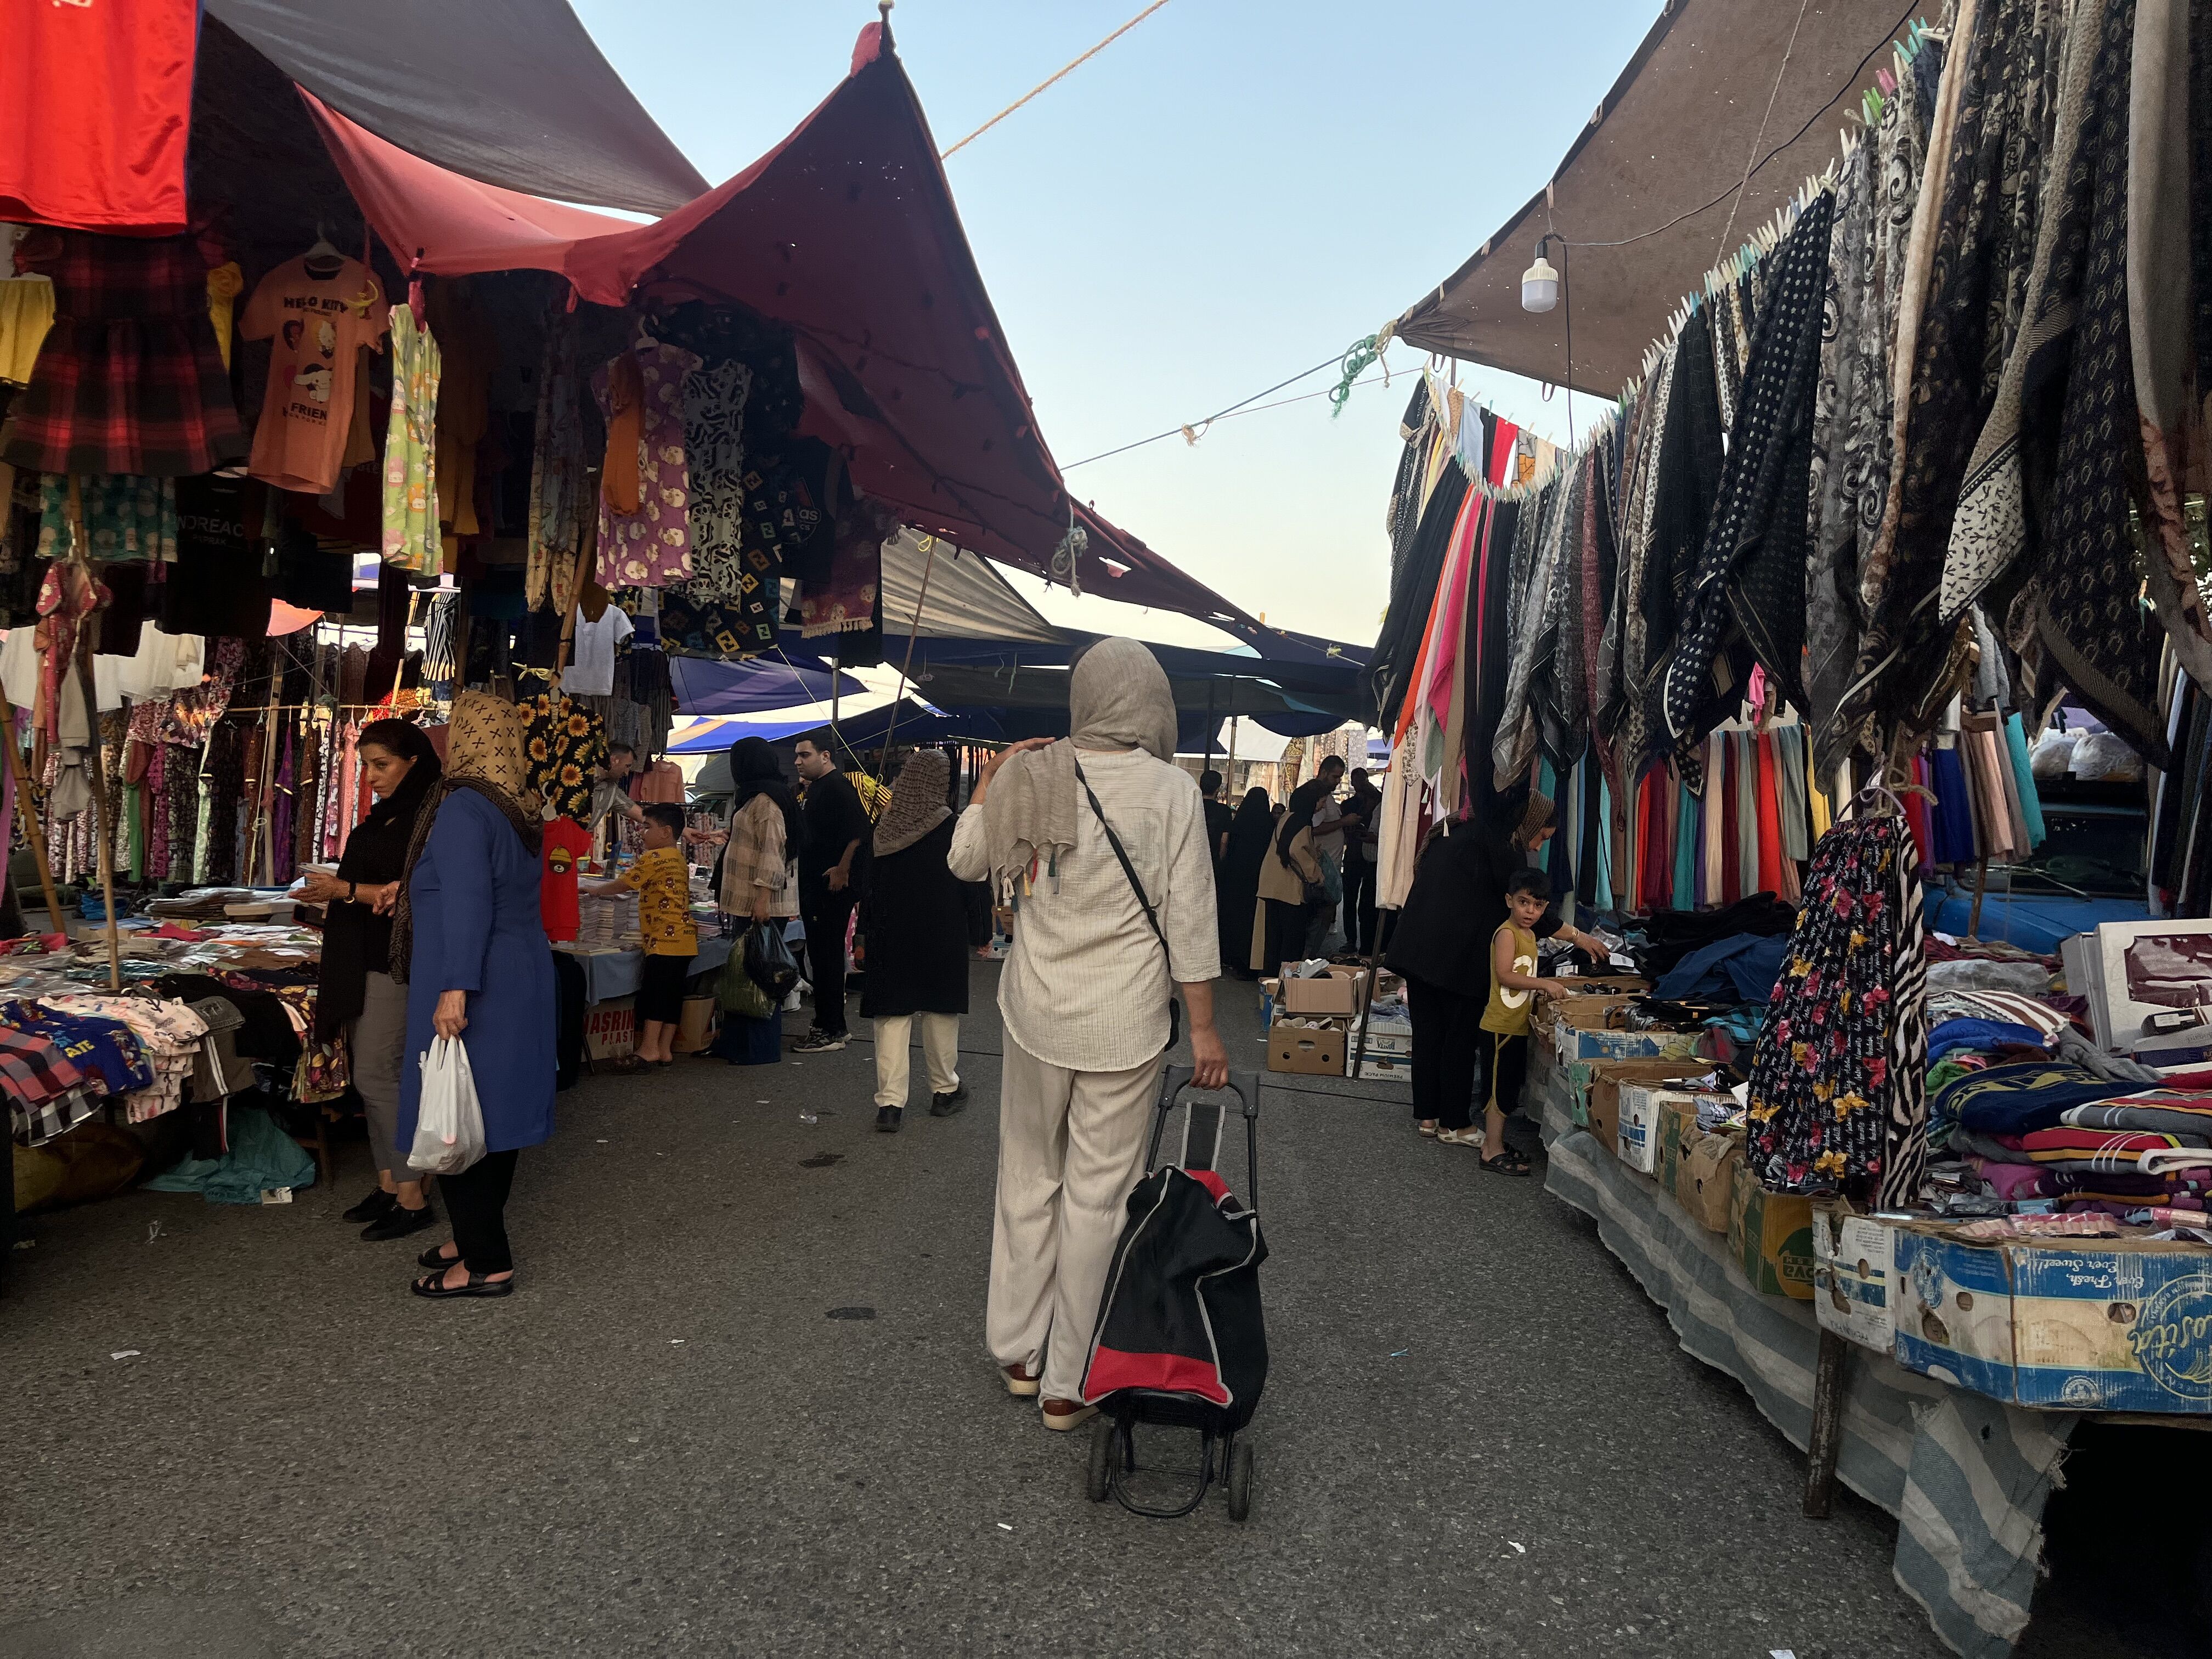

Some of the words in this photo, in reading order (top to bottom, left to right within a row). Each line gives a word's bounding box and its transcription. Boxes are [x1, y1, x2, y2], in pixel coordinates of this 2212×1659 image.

[1376, 1040, 1395, 1049] BONITA
[2086, 1260, 2118, 1273] Ever
[2066, 1273, 2112, 1289] Fresh,
[2115, 1276, 2144, 1289] Ever
[2128, 1315, 2212, 1359] osita
